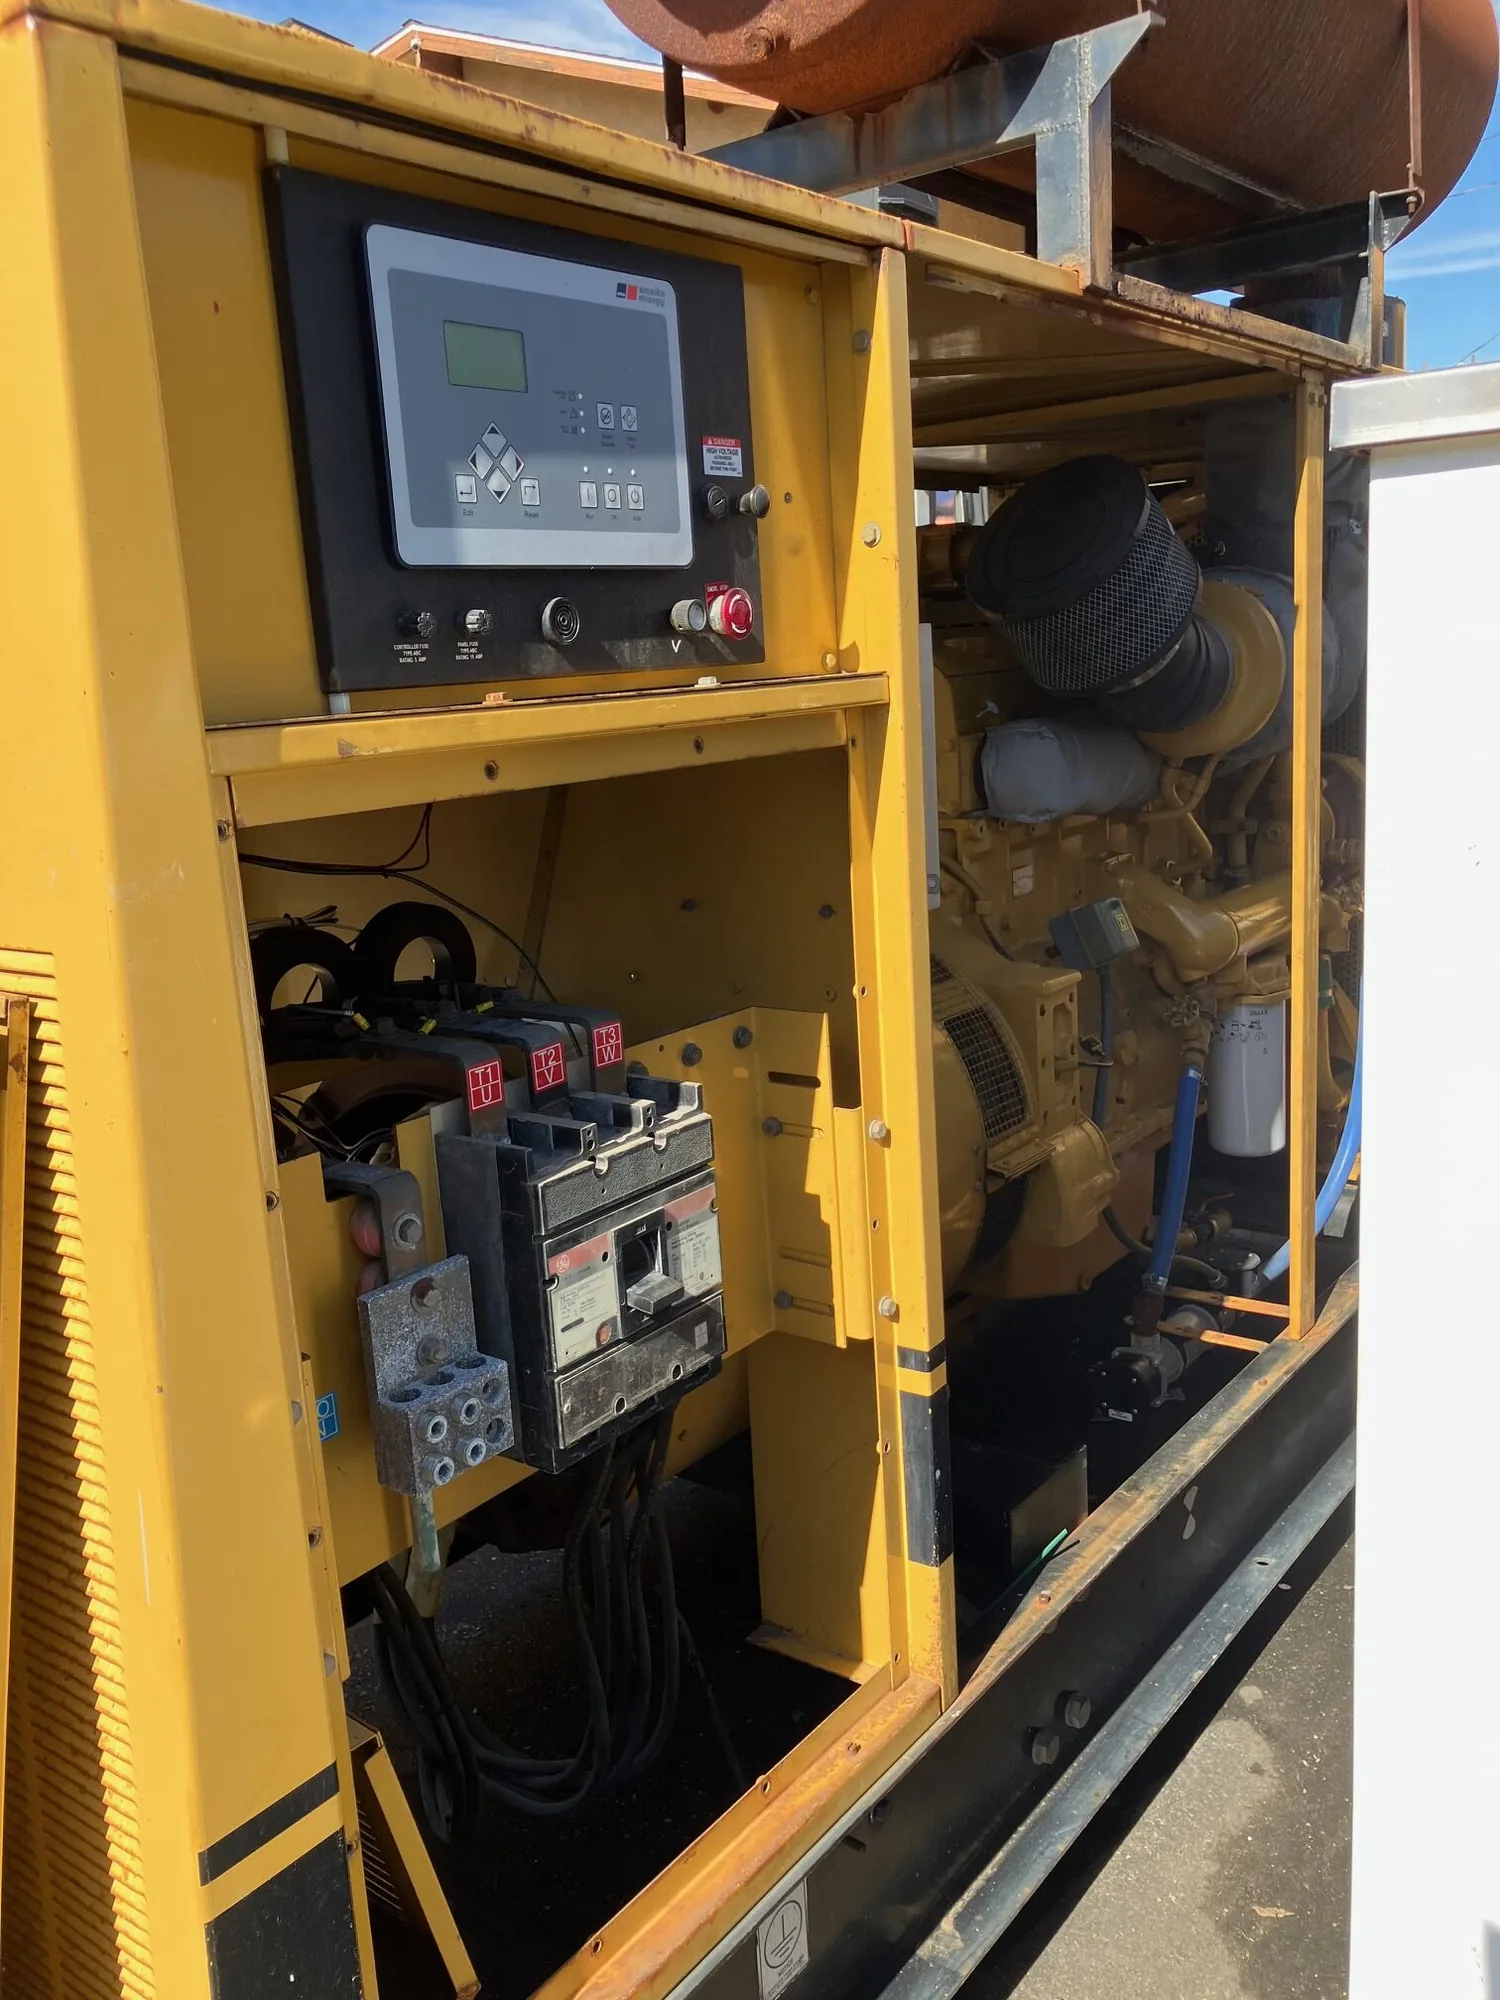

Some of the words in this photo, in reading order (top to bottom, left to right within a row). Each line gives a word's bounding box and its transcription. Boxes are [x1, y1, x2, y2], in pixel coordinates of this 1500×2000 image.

[713, 438, 736, 446] DANGER
[718, 448, 739, 456] VOLTAGE
[462, 508, 474, 516] Edit
[600, 1027, 617, 1044] T3
[538, 1048, 557, 1067] T2
[602, 1046, 616, 1063] W
[474, 1067, 493, 1087] T1
[543, 1066, 554, 1084] V
[481, 1085, 493, 1103] U
